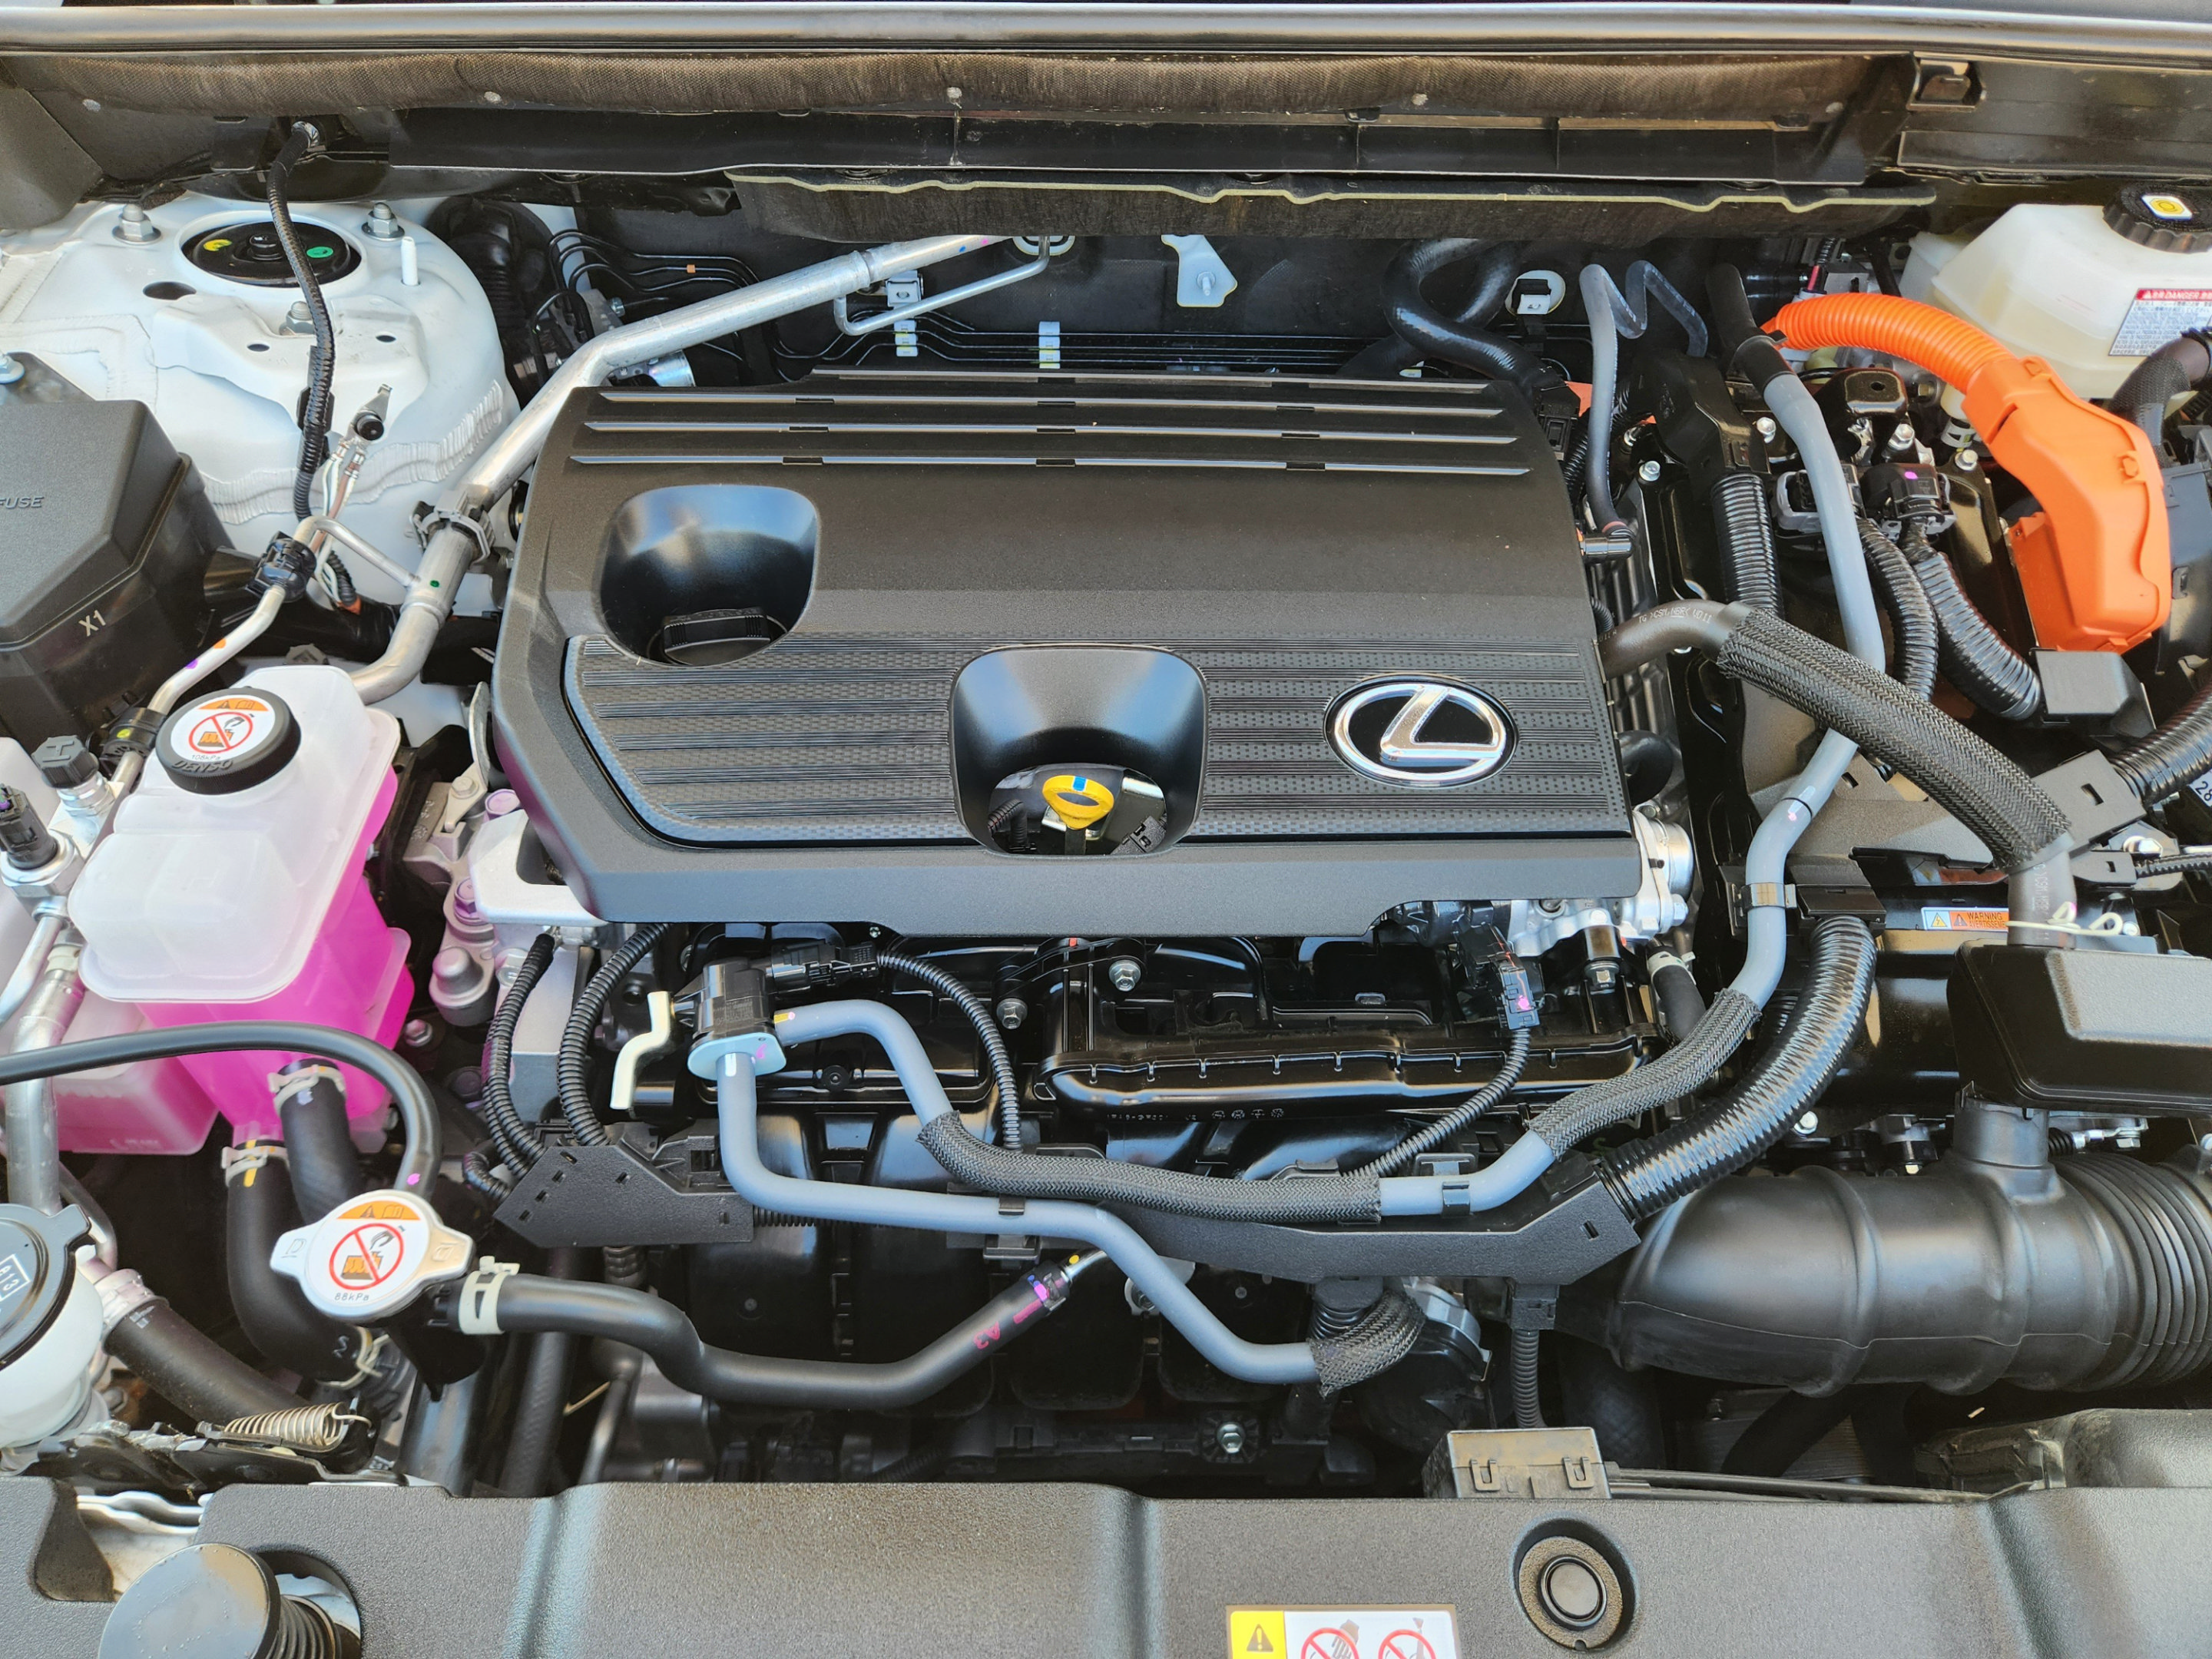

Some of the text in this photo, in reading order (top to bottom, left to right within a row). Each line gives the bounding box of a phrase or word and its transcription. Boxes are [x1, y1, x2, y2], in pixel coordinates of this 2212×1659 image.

[78, 610, 106, 637] X1
[171, 760, 233, 773] DENSO
[334, 1292, 369, 1302] 88kPa
